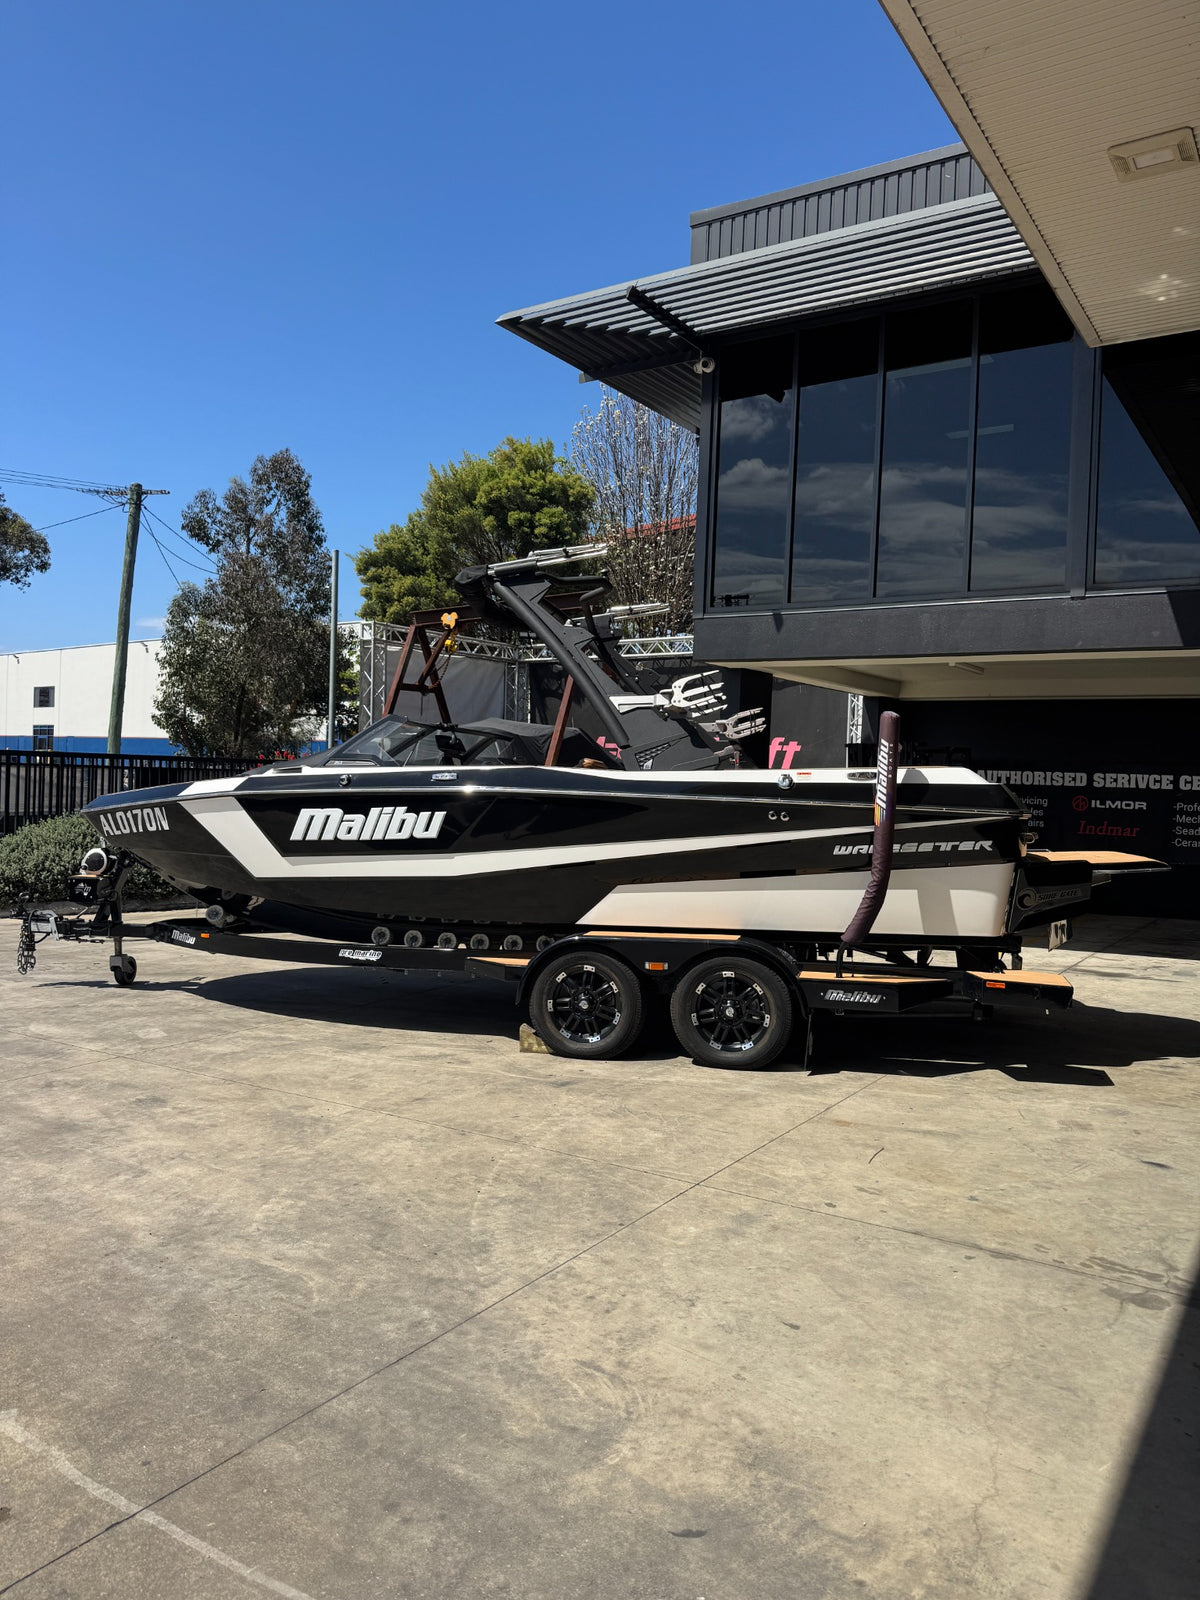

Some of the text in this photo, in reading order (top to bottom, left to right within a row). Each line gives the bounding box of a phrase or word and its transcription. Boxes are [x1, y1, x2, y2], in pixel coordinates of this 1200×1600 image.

[1093, 772, 1174, 790] SERIVCE
[1091, 800, 1147, 810] ILMOR
[290, 806, 447, 841] Malibu
[1077, 820, 1141, 837] Indmar
